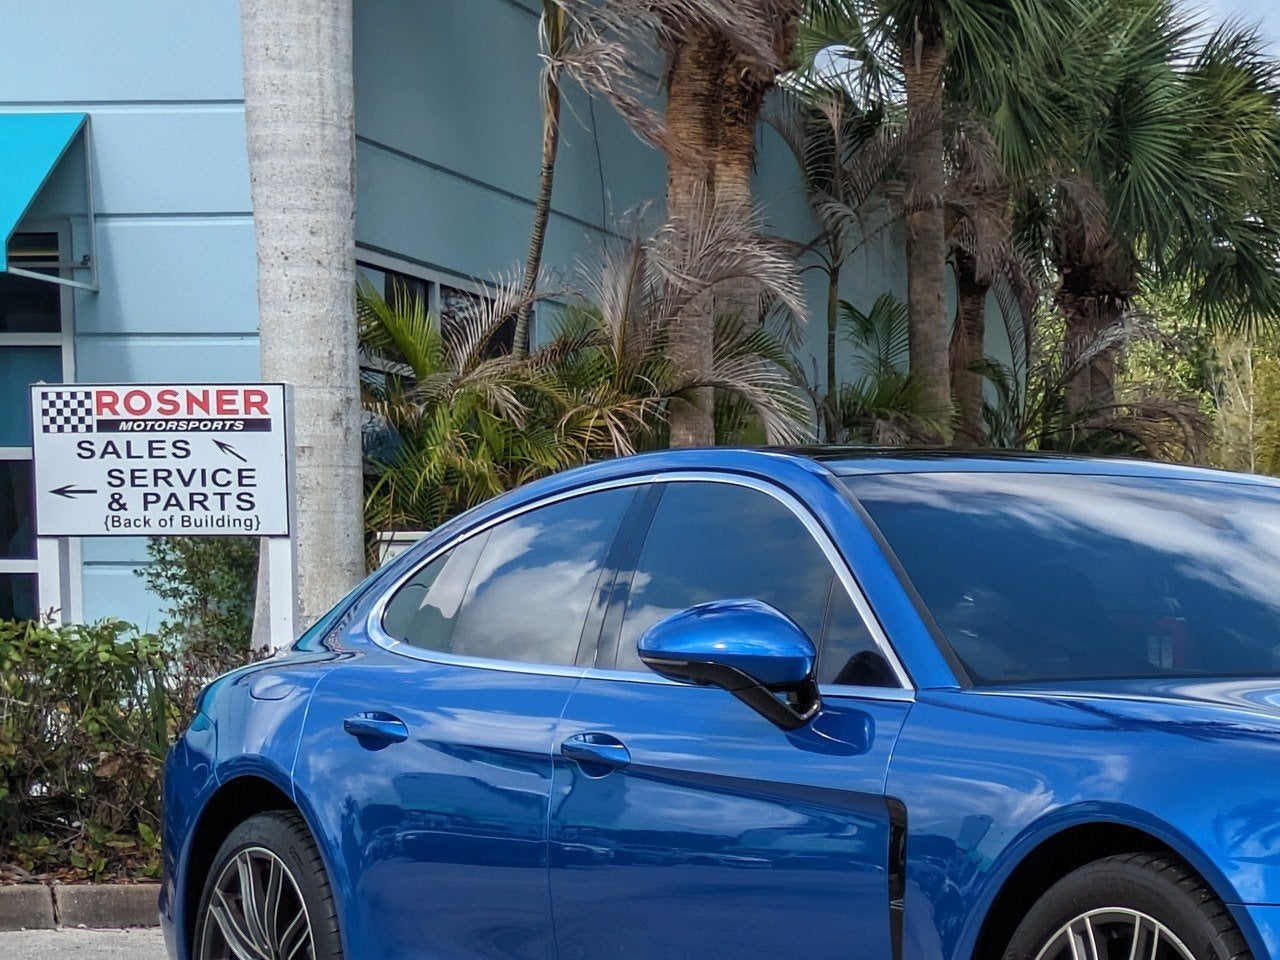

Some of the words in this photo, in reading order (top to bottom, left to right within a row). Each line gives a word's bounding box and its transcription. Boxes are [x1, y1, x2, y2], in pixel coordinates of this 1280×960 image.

[95, 389, 270, 416] ROSNER
[118, 420, 245, 431] MOTORSPORTS
[76, 440, 191, 459] SALES
[107, 468, 257, 488] SERVICE
[107, 492, 128, 512] &
[143, 492, 256, 512] PARTS
[103, 515, 152, 529] {Back
[158, 515, 175, 528] of
[181, 515, 261, 530] Building}
